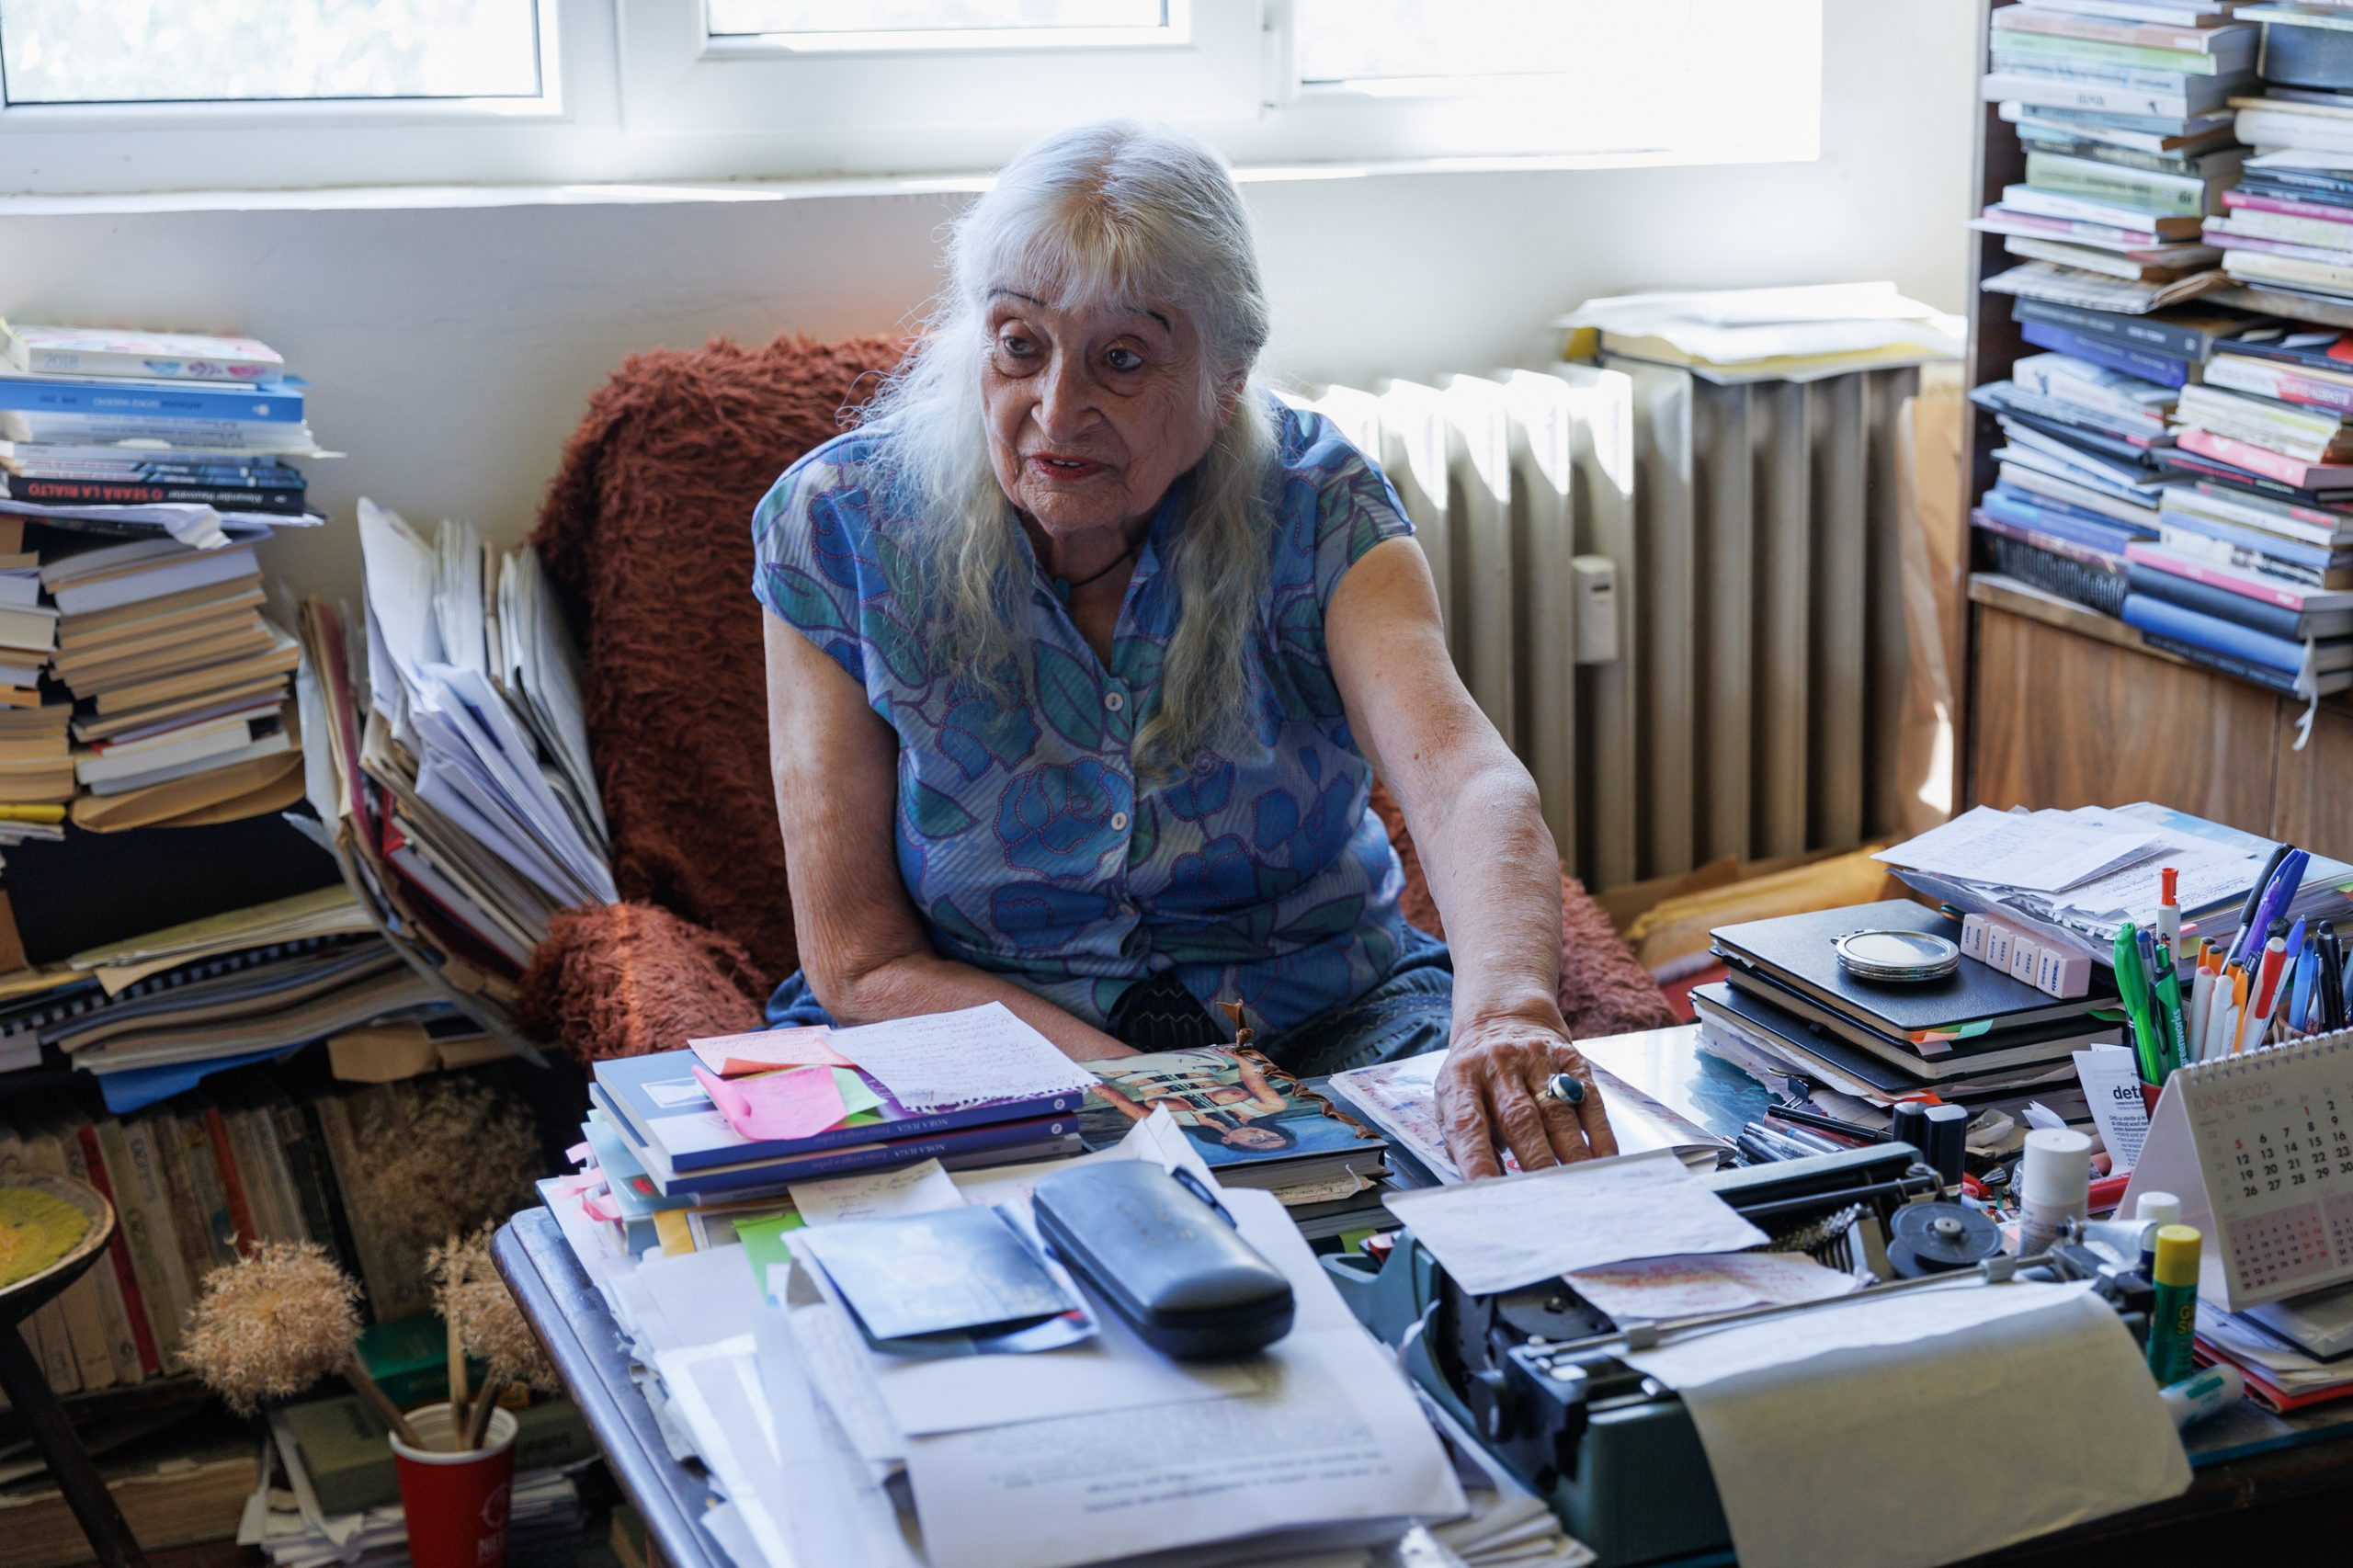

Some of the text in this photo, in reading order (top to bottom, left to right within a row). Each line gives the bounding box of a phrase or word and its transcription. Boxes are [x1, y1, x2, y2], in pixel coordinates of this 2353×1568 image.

[28, 483, 79, 498] RIALTO
[83, 485, 100, 499] LA
[152, 488, 164, 501] O
[2171, 1008, 2189, 1068] greenworks
[2193, 1082, 2273, 1113] IUNIE 2023
[2303, 1106, 2310, 1118] 1
[2326, 1100, 2336, 1111] 2
[897, 1122, 920, 1132] IUGA
[922, 1118, 949, 1129] NORA
[2234, 1138, 2243, 1150] 5
[2259, 1133, 2268, 1144] 6
[2282, 1127, 2290, 1139] 7
[2307, 1120, 2315, 1132] 8
[2330, 1115, 2339, 1126] 9
[894, 1147, 917, 1157] IUGA
[919, 1143, 946, 1155] NORA
[2235, 1153, 2250, 1166] 12
[2260, 1147, 2274, 1160] 13
[2284, 1142, 2299, 1154] 14
[2308, 1136, 2323, 1148] 15
[2332, 1131, 2347, 1142] 16
[2239, 1169, 2254, 1182] 19
[2264, 1164, 2278, 1176] 20
[2287, 1157, 2301, 1170] 21
[2311, 1152, 2326, 1164] 22
[2336, 1146, 2350, 1158] 23
[2243, 1186, 2258, 1198] 26
[2267, 1178, 2281, 1191] 27
[2290, 1173, 2306, 1186] 28
[2314, 1166, 2330, 1179] 29
[2339, 1162, 2353, 1174] 30
